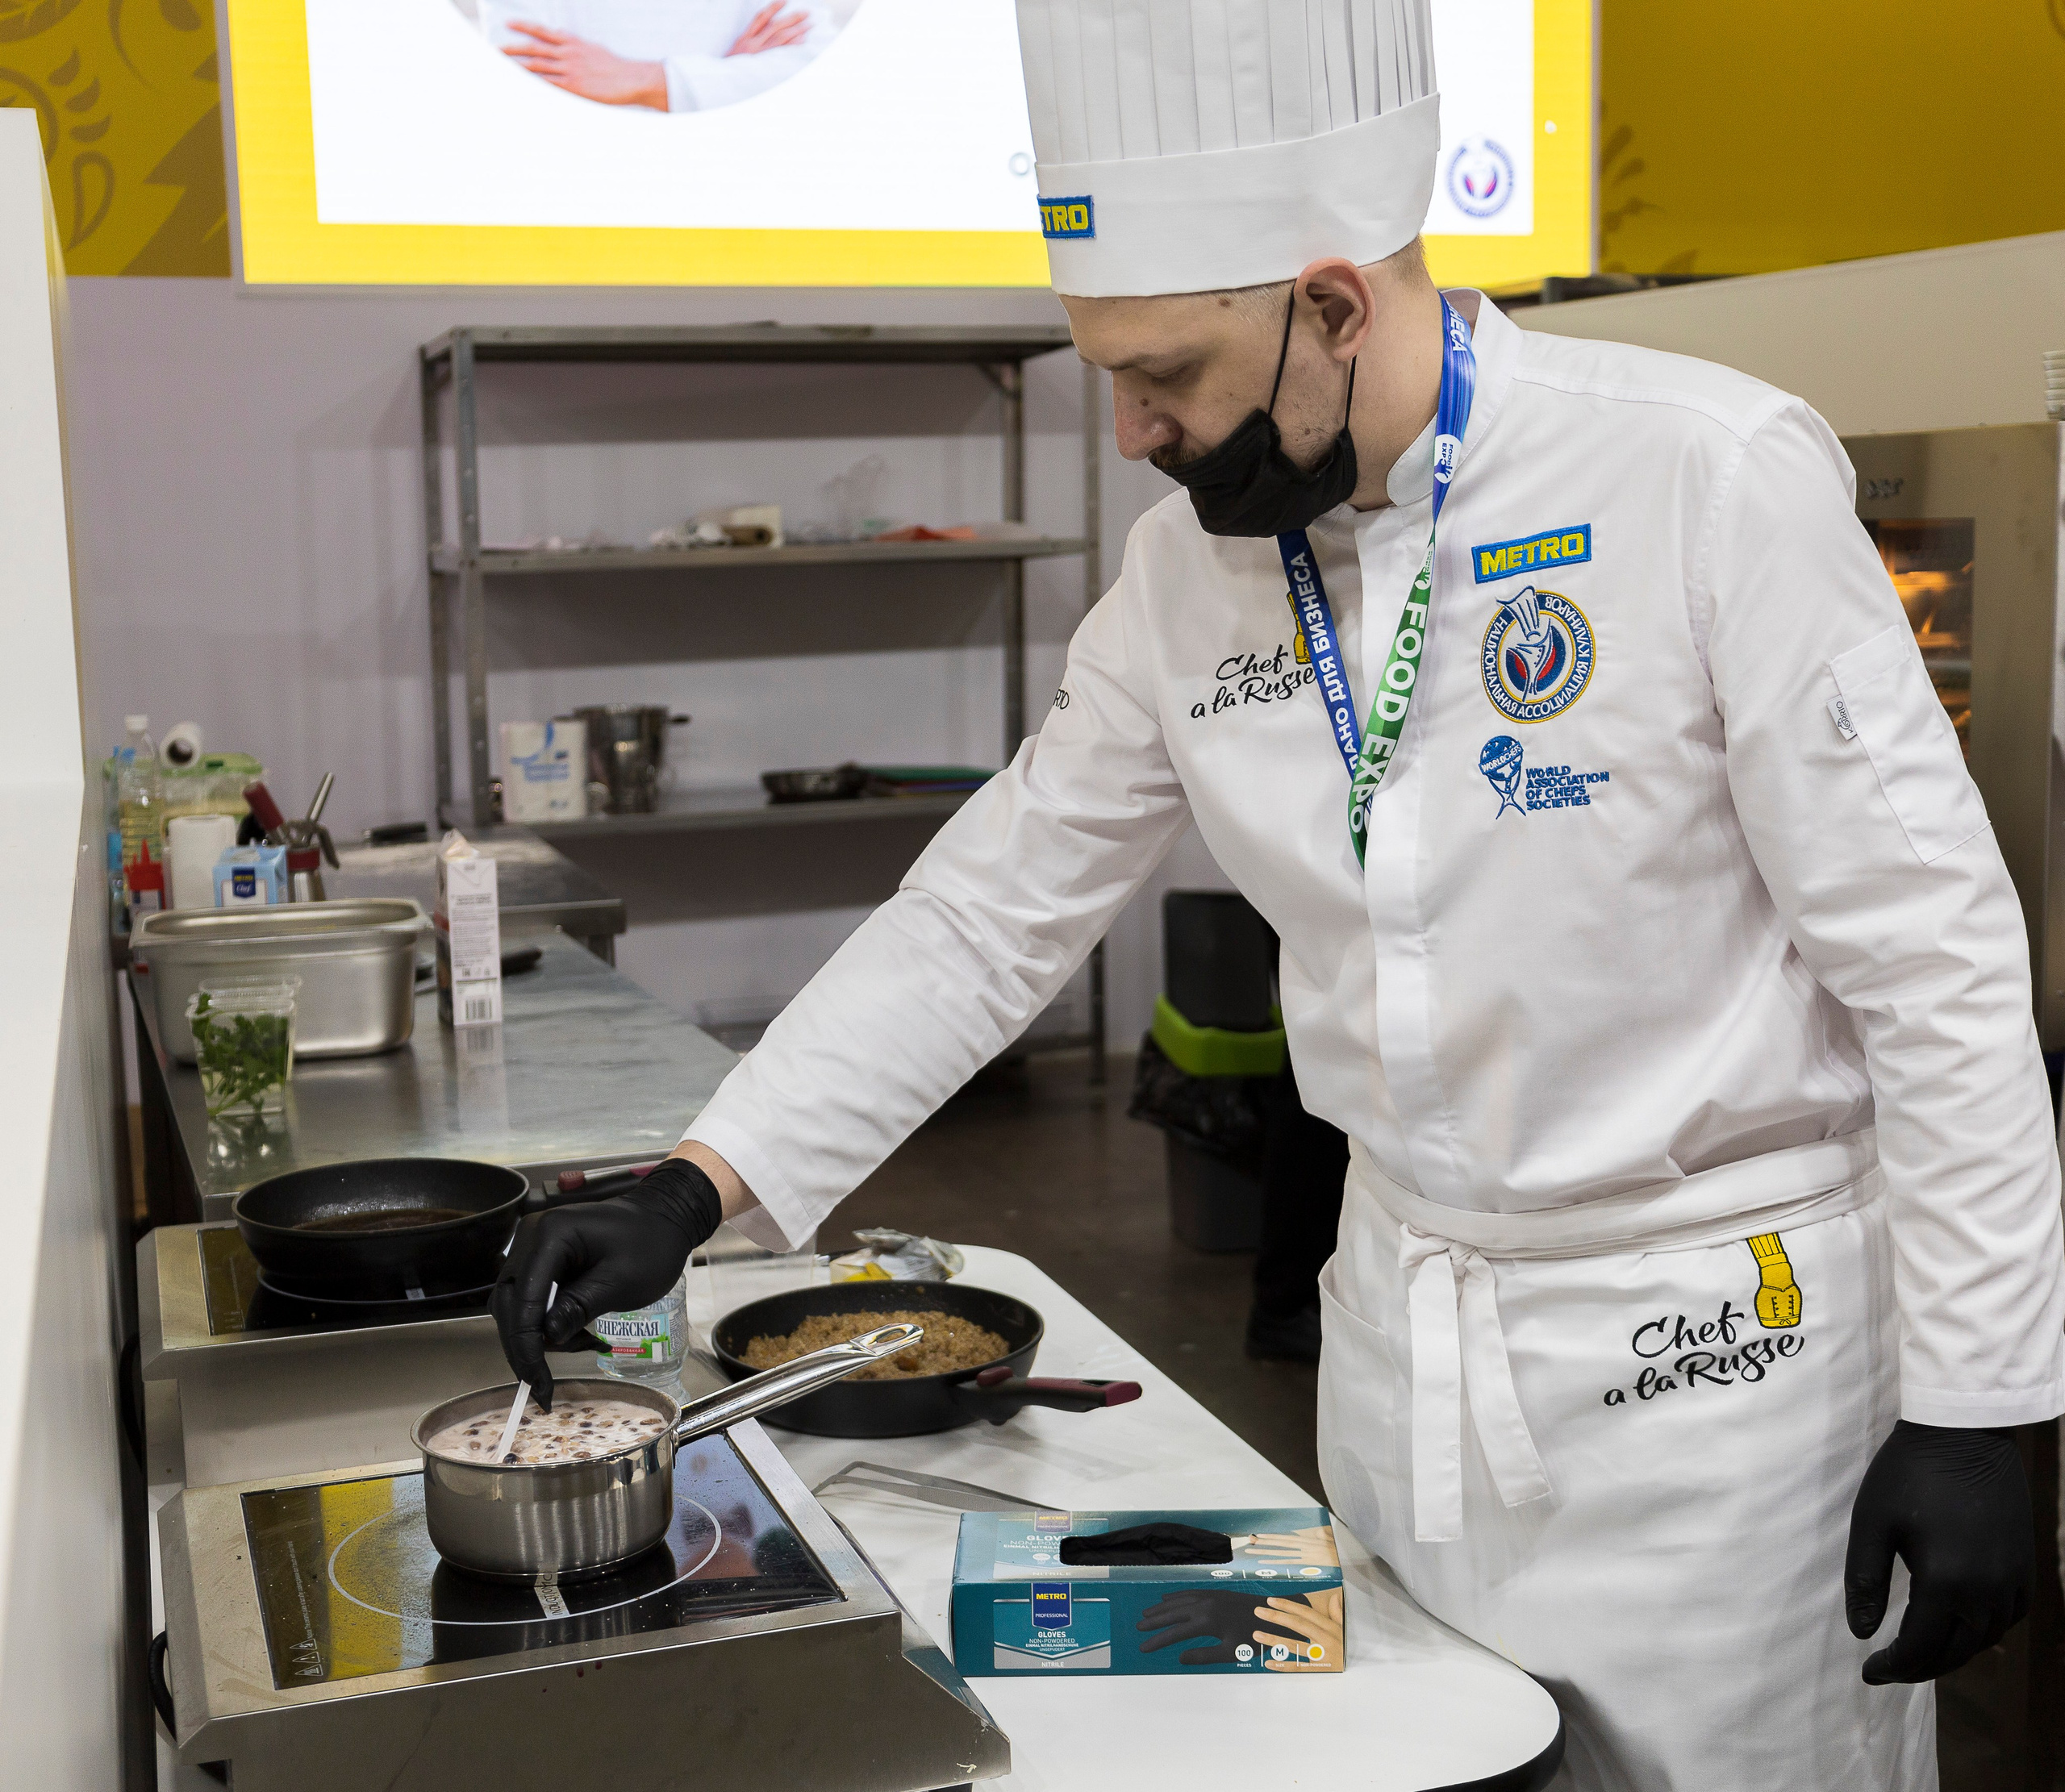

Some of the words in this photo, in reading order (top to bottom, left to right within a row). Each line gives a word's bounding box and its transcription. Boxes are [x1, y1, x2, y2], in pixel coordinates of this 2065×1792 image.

[1040, 204, 1089, 231] TRO
[1449, 306, 1467, 352] НЕСА
[1480, 532, 1584, 576] METRO
[1291, 551, 1331, 654] БИЗНЕСА
[1544, 596, 1591, 658] КУЛИНАРОВ
[1216, 644, 1289, 681] Chef
[1318, 655, 1347, 702] ДЛЯ
[1375, 601, 1428, 722] FOOD
[1483, 615, 1517, 715] НАЦИОНАЛЬНАЯ
[1191, 702, 1206, 719] a
[1212, 686, 1237, 714] la
[1238, 666, 1316, 705] Russe
[1518, 661, 1589, 718] АССОЦИАЦИЯ
[1481, 744, 1522, 773] WORLDCHEFS
[1525, 765, 1571, 779] WORLD
[1525, 771, 1610, 790] ASSOCIATION
[1350, 732, 1397, 833] EXPO
[1525, 789, 1542, 800] OF
[1545, 785, 1586, 801] CHEFS
[1525, 794, 1592, 811] SOCIETIES
[597, 1318, 659, 1336] ЕНЕЖСКАЯ
[1632, 1300, 1745, 1359] Chef
[1603, 1388, 1627, 1407] a
[1633, 1366, 1678, 1400] la
[1674, 1334, 1805, 1388] Russe
[1275, 1648, 1284, 1657] M
